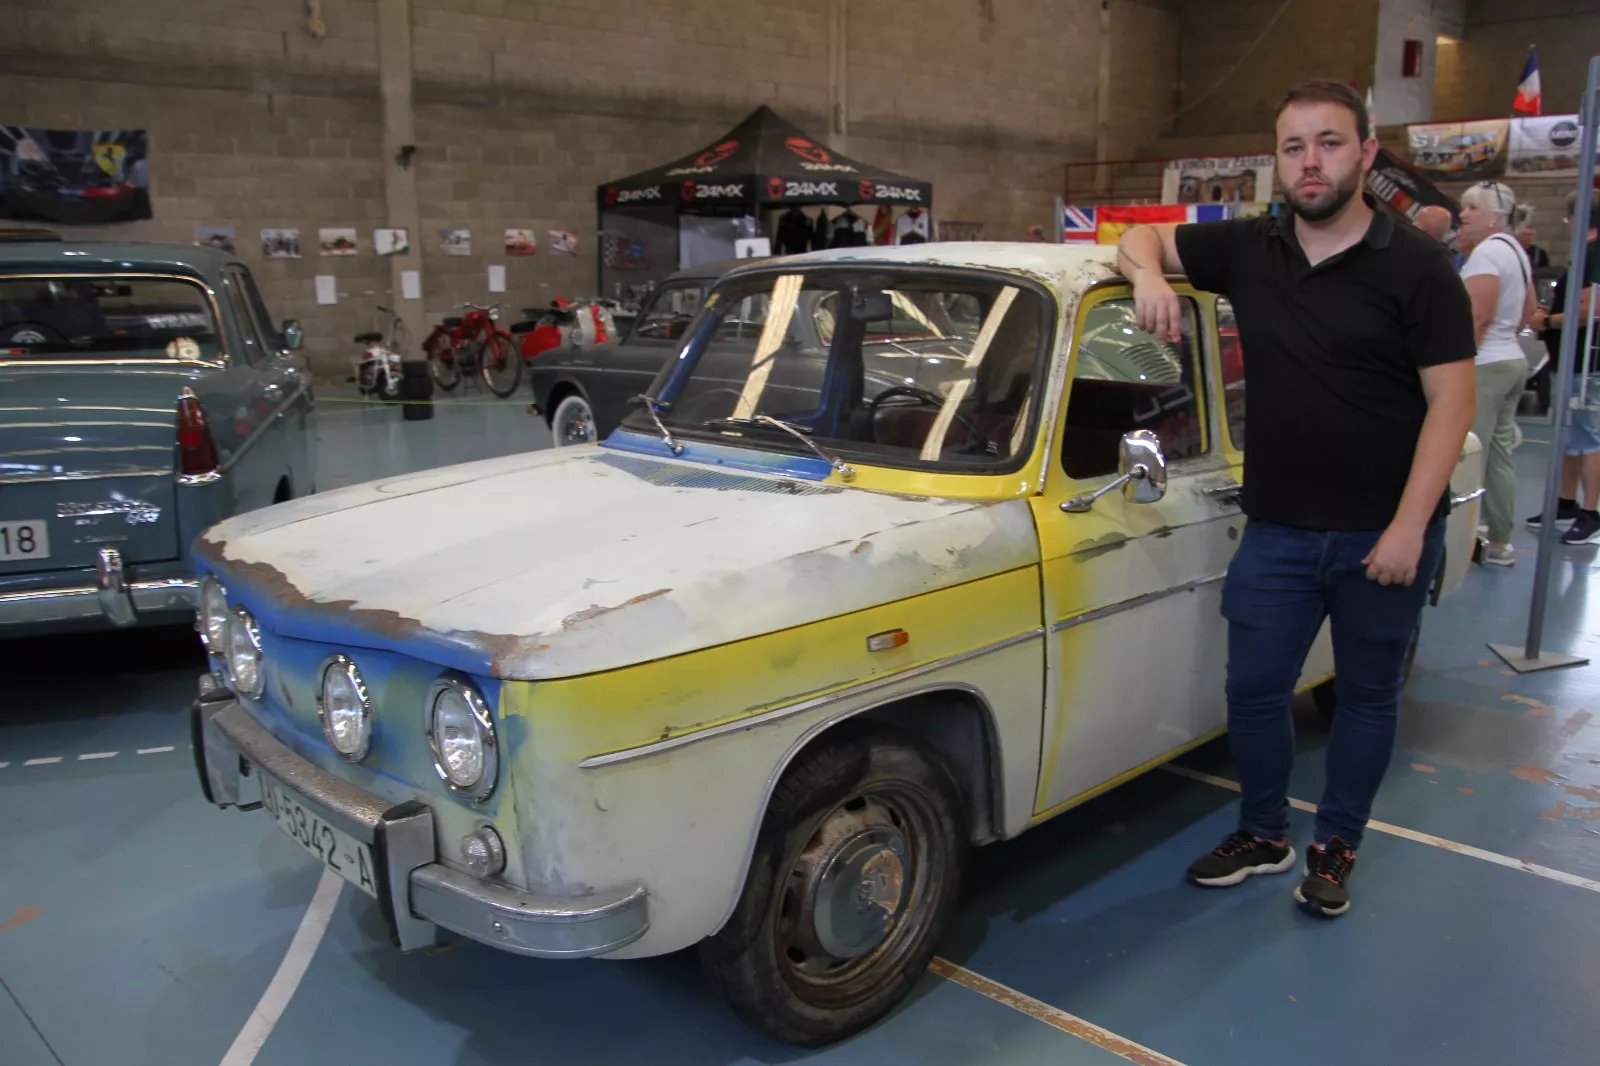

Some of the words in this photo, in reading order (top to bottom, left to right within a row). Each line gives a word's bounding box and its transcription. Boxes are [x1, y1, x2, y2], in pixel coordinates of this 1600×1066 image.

[617, 186, 662, 203] 24MX
[696, 184, 744, 198] 24MX
[785, 182, 838, 197] 24MX
[875, 184, 922, 201] 24MX
